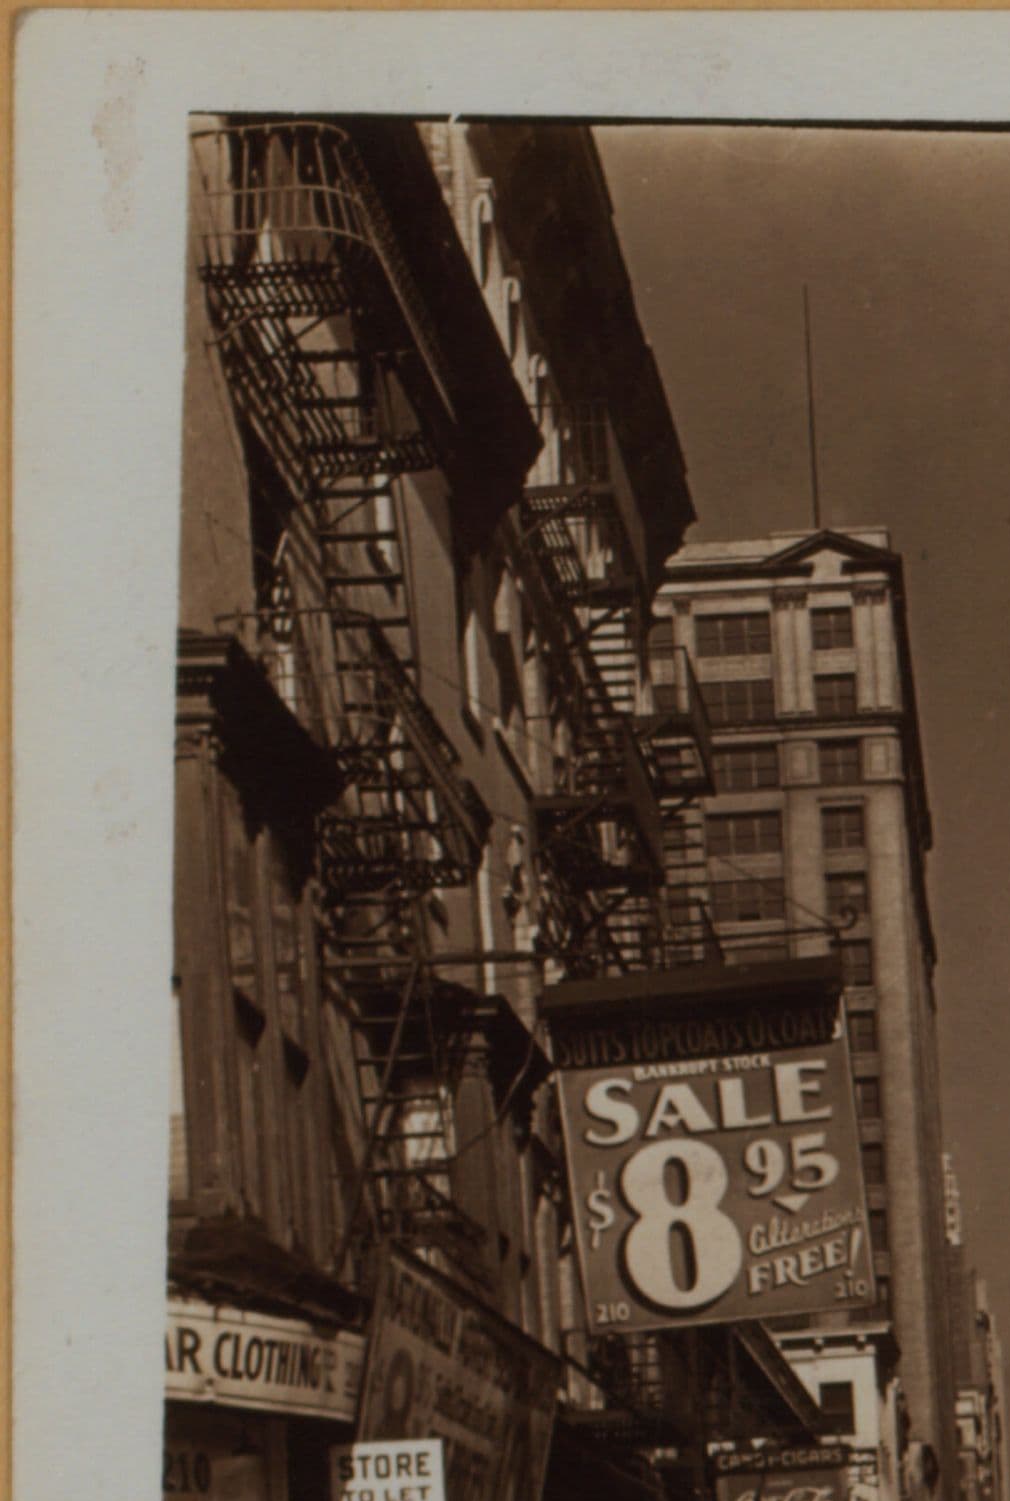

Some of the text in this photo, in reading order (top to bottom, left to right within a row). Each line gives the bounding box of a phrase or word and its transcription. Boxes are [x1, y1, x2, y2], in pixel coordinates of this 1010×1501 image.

[557, 1028, 627, 1067] SUITS
[630, 1014, 745, 1062] TOPCOATS
[633, 1053, 771, 1081] BANKRUPT STOCK
[584, 1060, 832, 1146] SALE
[748, 1227, 863, 1294] FREE!
[833, 1279, 868, 1299] 210
[596, 1303, 631, 1323] 210
[214, 1332, 322, 1390] CLOTHING
[339, 1450, 432, 1483] STORE
